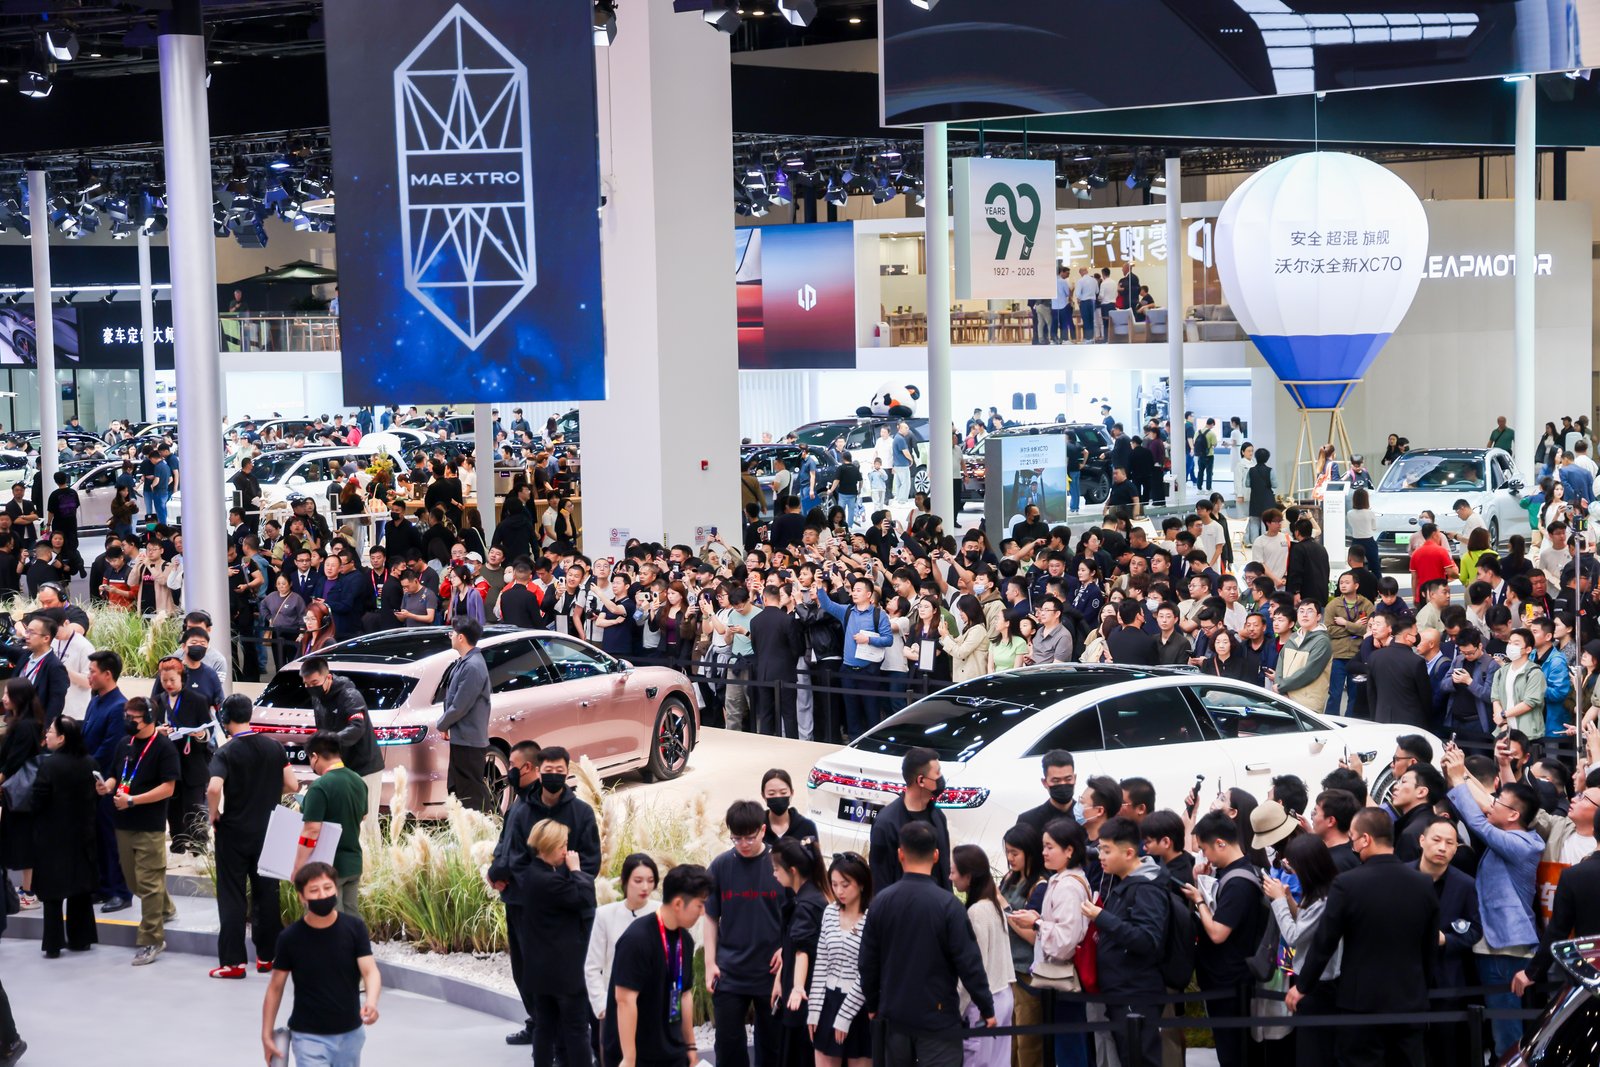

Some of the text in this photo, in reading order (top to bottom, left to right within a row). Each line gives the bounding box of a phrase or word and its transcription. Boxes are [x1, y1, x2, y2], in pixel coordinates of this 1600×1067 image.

[411, 171, 520, 186] MAEXTRO
[985, 207, 1006, 215] YEARS
[1291, 229, 1390, 247] 安全 超混 旗舰
[1017, 268, 1035, 276] 2026
[1274, 256, 1402, 274] 沃尔沃全新XC70
[102, 326, 174, 344] 豪车定大师
